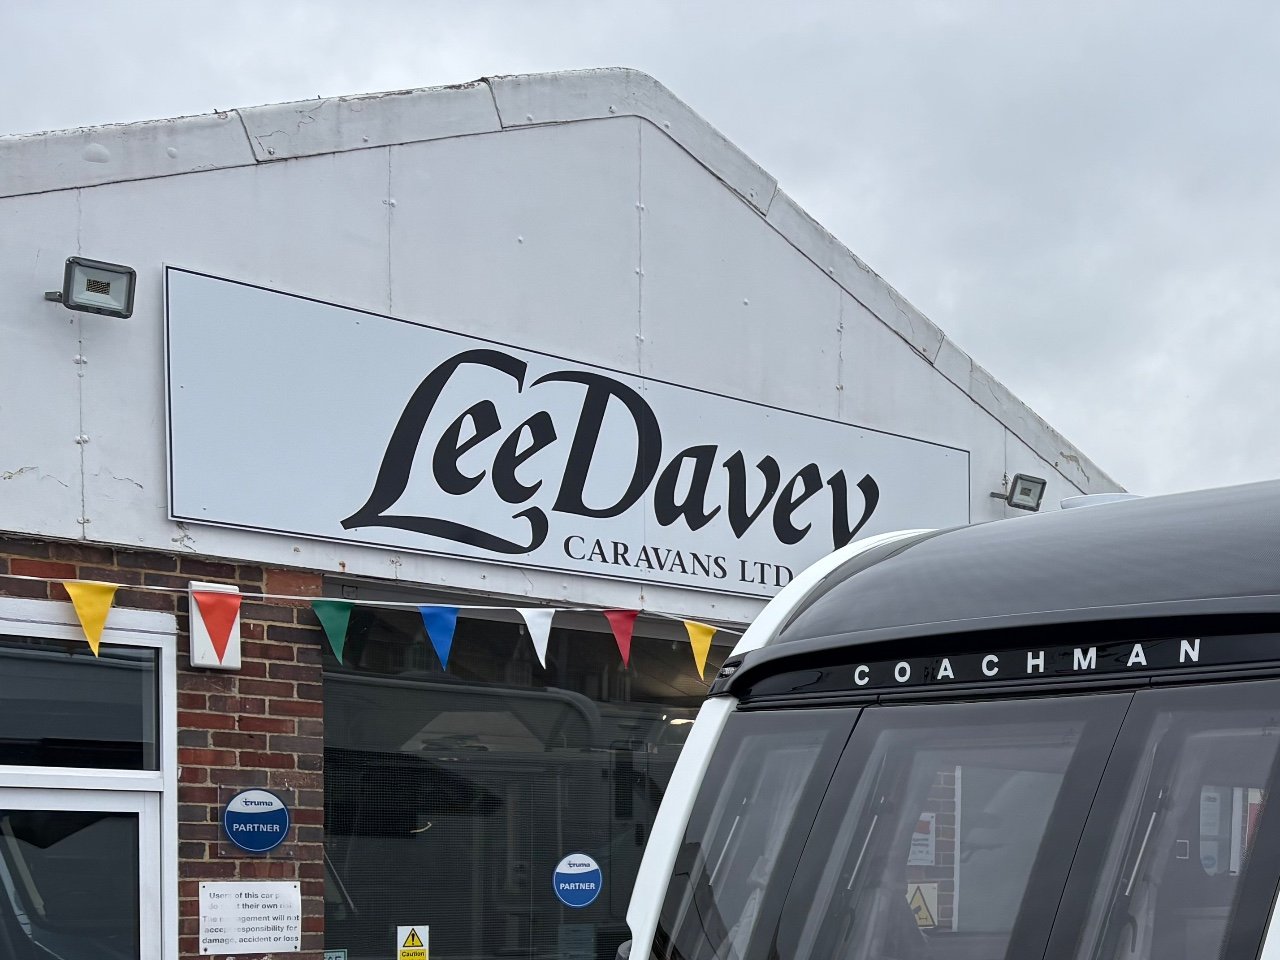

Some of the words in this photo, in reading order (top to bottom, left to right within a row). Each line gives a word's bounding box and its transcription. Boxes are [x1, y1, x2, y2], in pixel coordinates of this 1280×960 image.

[563, 535, 728, 579] CARAVANS
[739, 559, 794, 588] LTD
[854, 638, 1201, 686] COACHMAN
[241, 798, 273, 807] truma
[233, 823, 280, 832] PARTNER
[559, 882, 596, 890] PARTNER
[238, 935, 272, 943] accident
